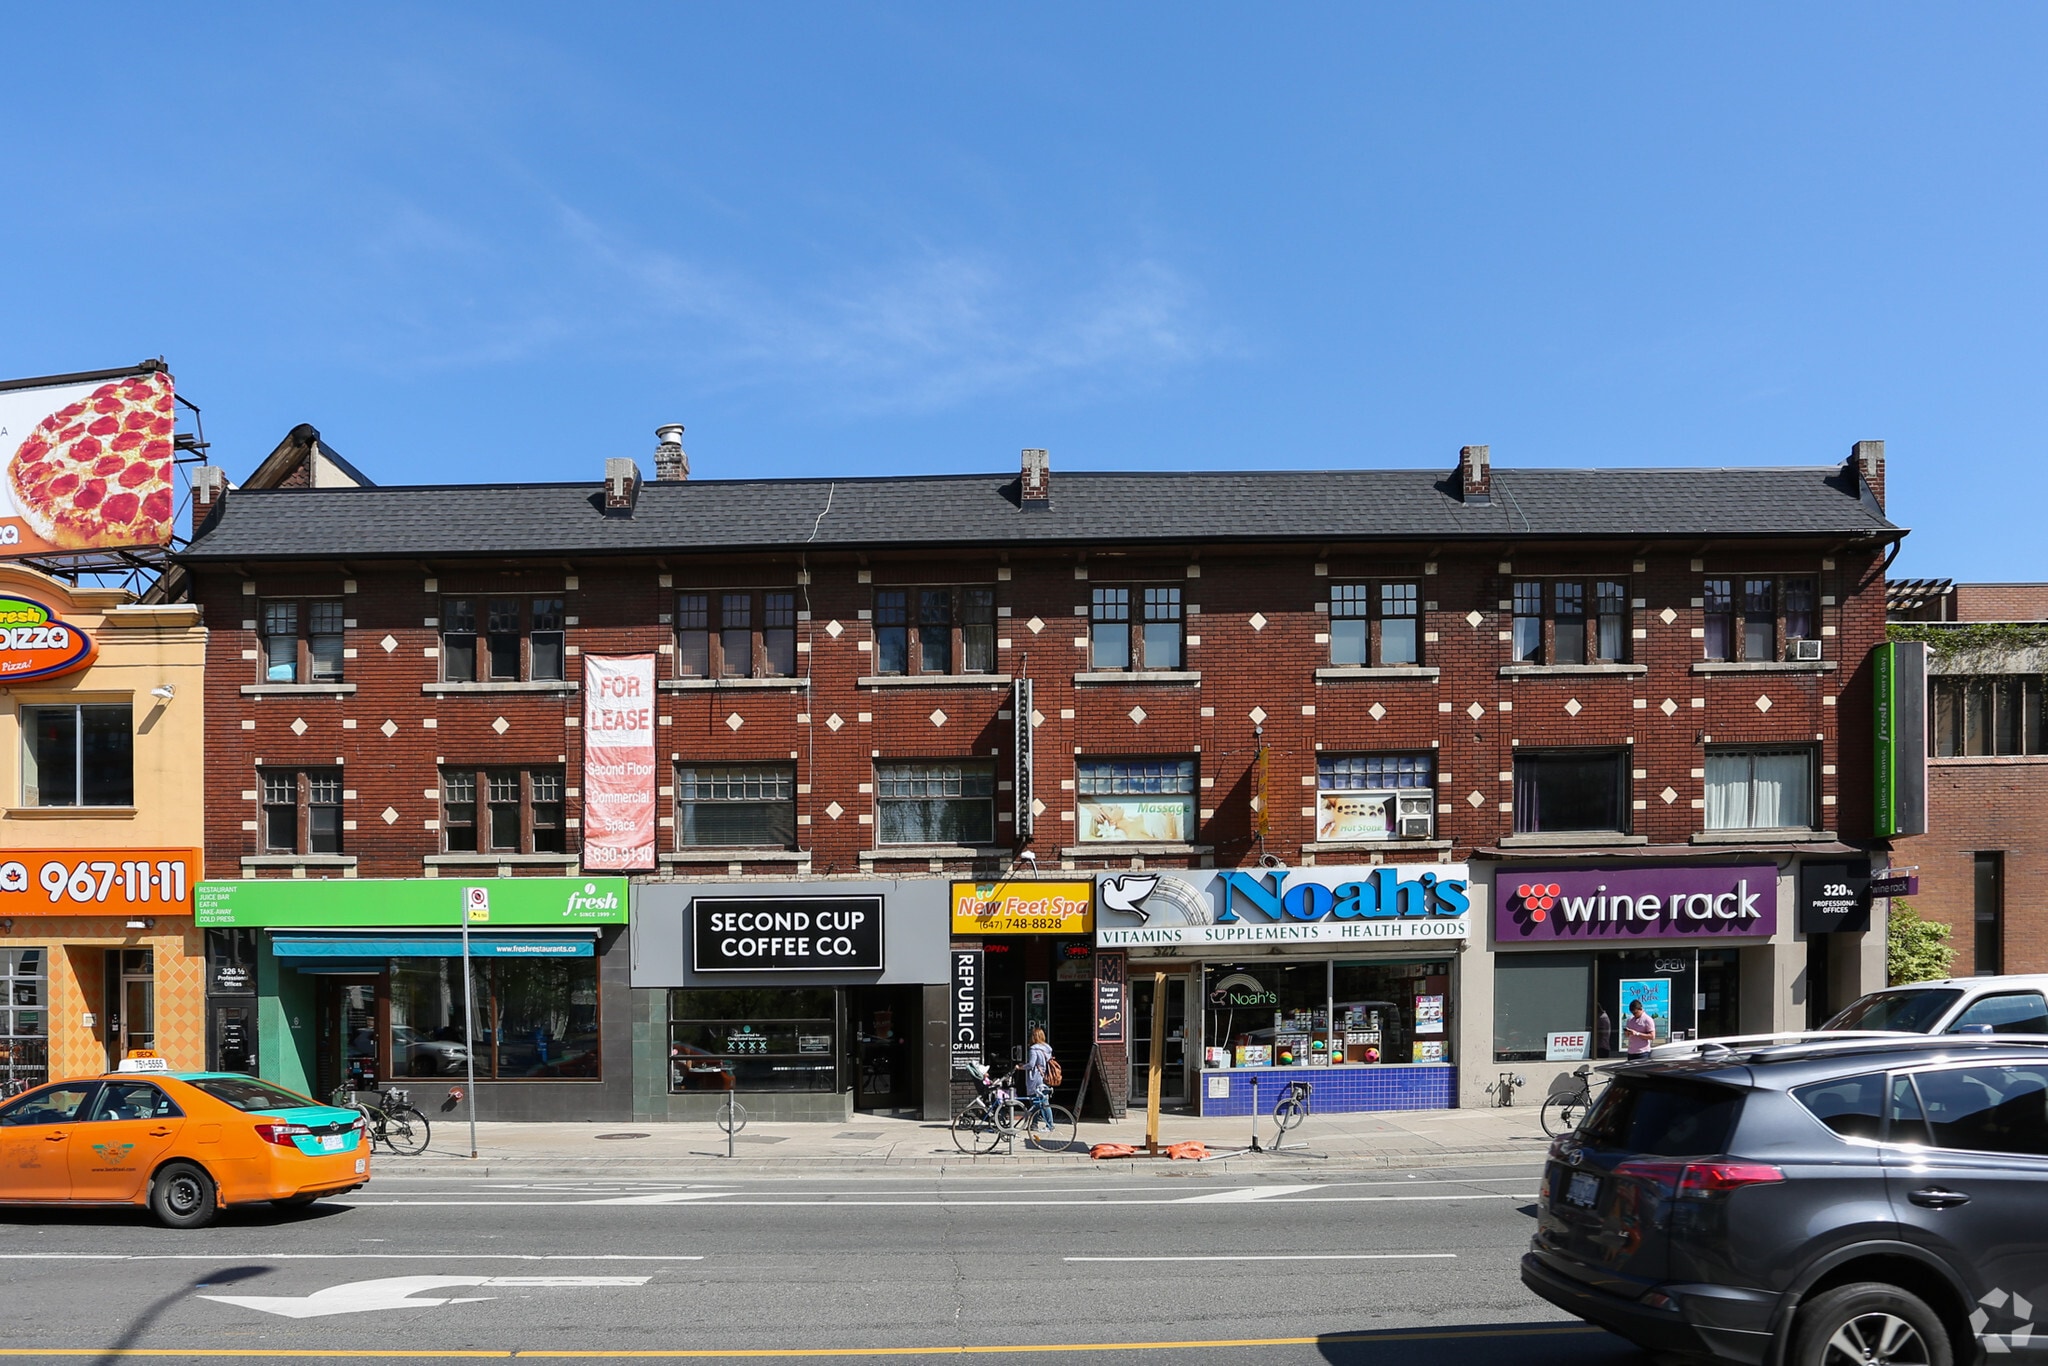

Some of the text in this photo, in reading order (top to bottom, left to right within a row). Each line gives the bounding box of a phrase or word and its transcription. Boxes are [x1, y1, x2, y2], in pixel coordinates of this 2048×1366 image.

[600, 675, 641, 698] FOR
[1880, 674, 1888, 699] every
[591, 708, 650, 731] LEASE
[1878, 702, 1890, 744] fresh
[587, 762, 653, 776] Second Floor
[591, 790, 650, 804] Commercial
[1137, 803, 1191, 815] Massage
[605, 819, 636, 834] Space
[593, 847, 653, 863] 630-9130
[1218, 867, 1470, 921] Noah's
[1823, 884, 1847, 897] 320
[1873, 881, 1908, 894] wine rack
[562, 891, 618, 917] fresh
[1560, 879, 1762, 922] wine rack
[958, 897, 1090, 920] New Feet Spa
[1822, 906, 1849, 914] OFFICES
[217, 915, 235, 923] PRESS
[711, 911, 865, 932] SECOND CUP
[980, 918, 1062, 930] (647) 748-8828
[1103, 922, 1466, 943] VITAMINS SUPPLEMENTS HEALTH FOODS
[496, 945, 577, 953] www.freshrestaurants.ca
[721, 936, 857, 957] COFFEE CO.
[984, 944, 1009, 953] OPEN
[222, 967, 237, 975] 326
[1655, 958, 1686, 970] OPEN
[958, 954, 975, 1042] REPUBLIC
[1230, 991, 1277, 1005] Noah's
[1554, 1036, 1584, 1047] FREE
